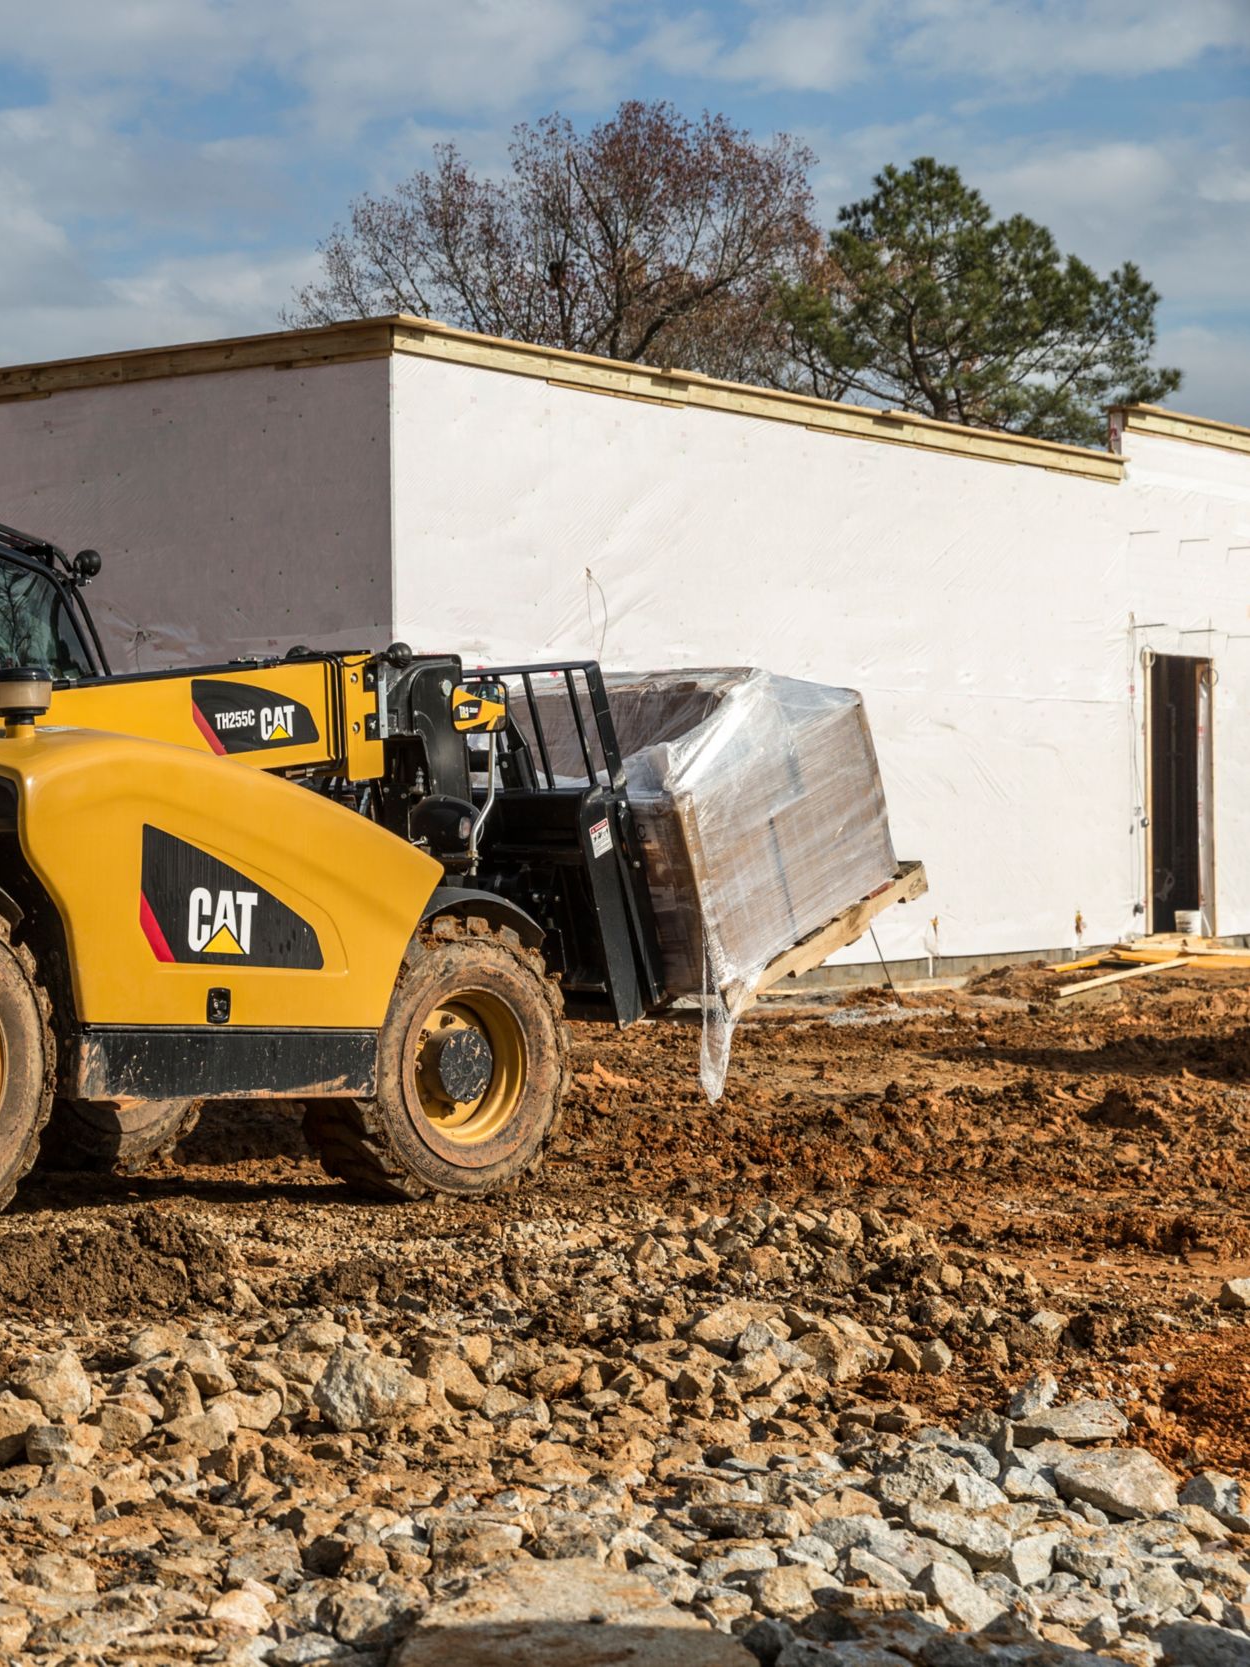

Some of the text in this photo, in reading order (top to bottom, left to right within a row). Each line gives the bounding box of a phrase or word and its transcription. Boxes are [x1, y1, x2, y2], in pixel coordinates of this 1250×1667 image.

[214, 704, 295, 741] TH255C CAT
[187, 886, 259, 956] CAT
